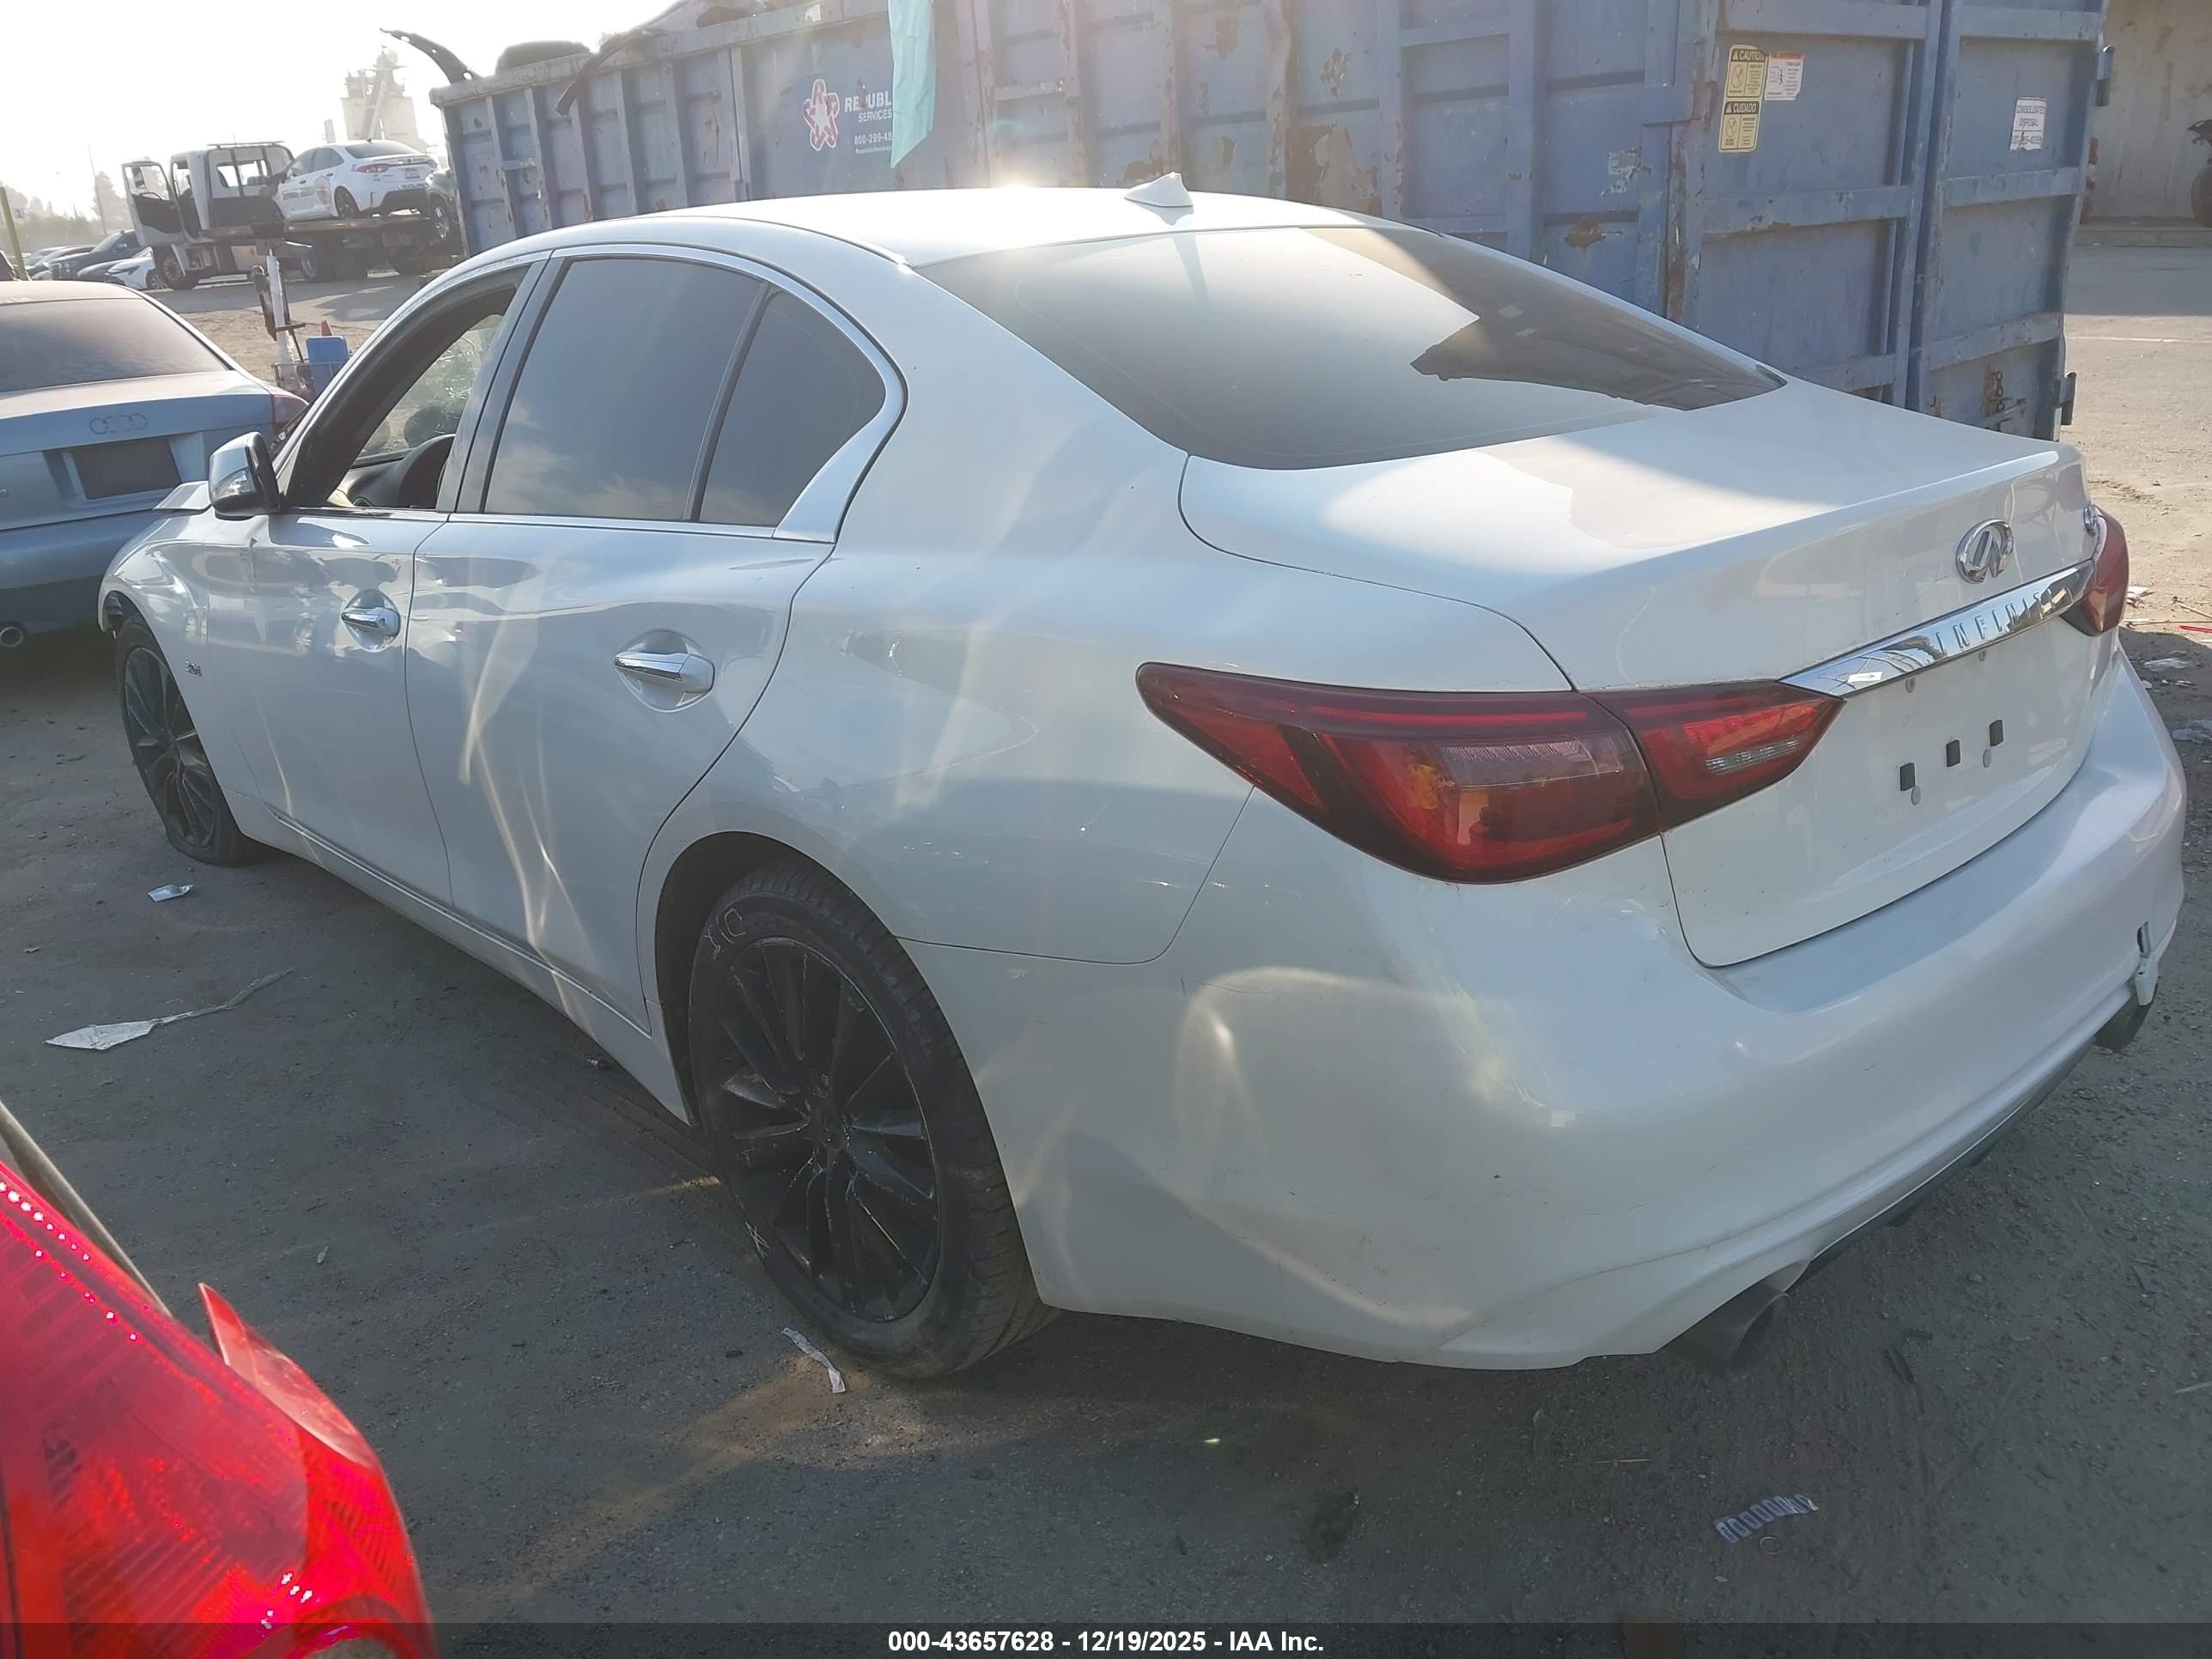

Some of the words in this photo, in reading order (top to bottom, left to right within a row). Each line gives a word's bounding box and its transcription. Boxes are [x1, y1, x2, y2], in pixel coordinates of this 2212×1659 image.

[1733, 102, 1757, 113] CUIDADO
[859, 109, 892, 122] SERVICES
[1935, 588, 2056, 655] INFINITI
